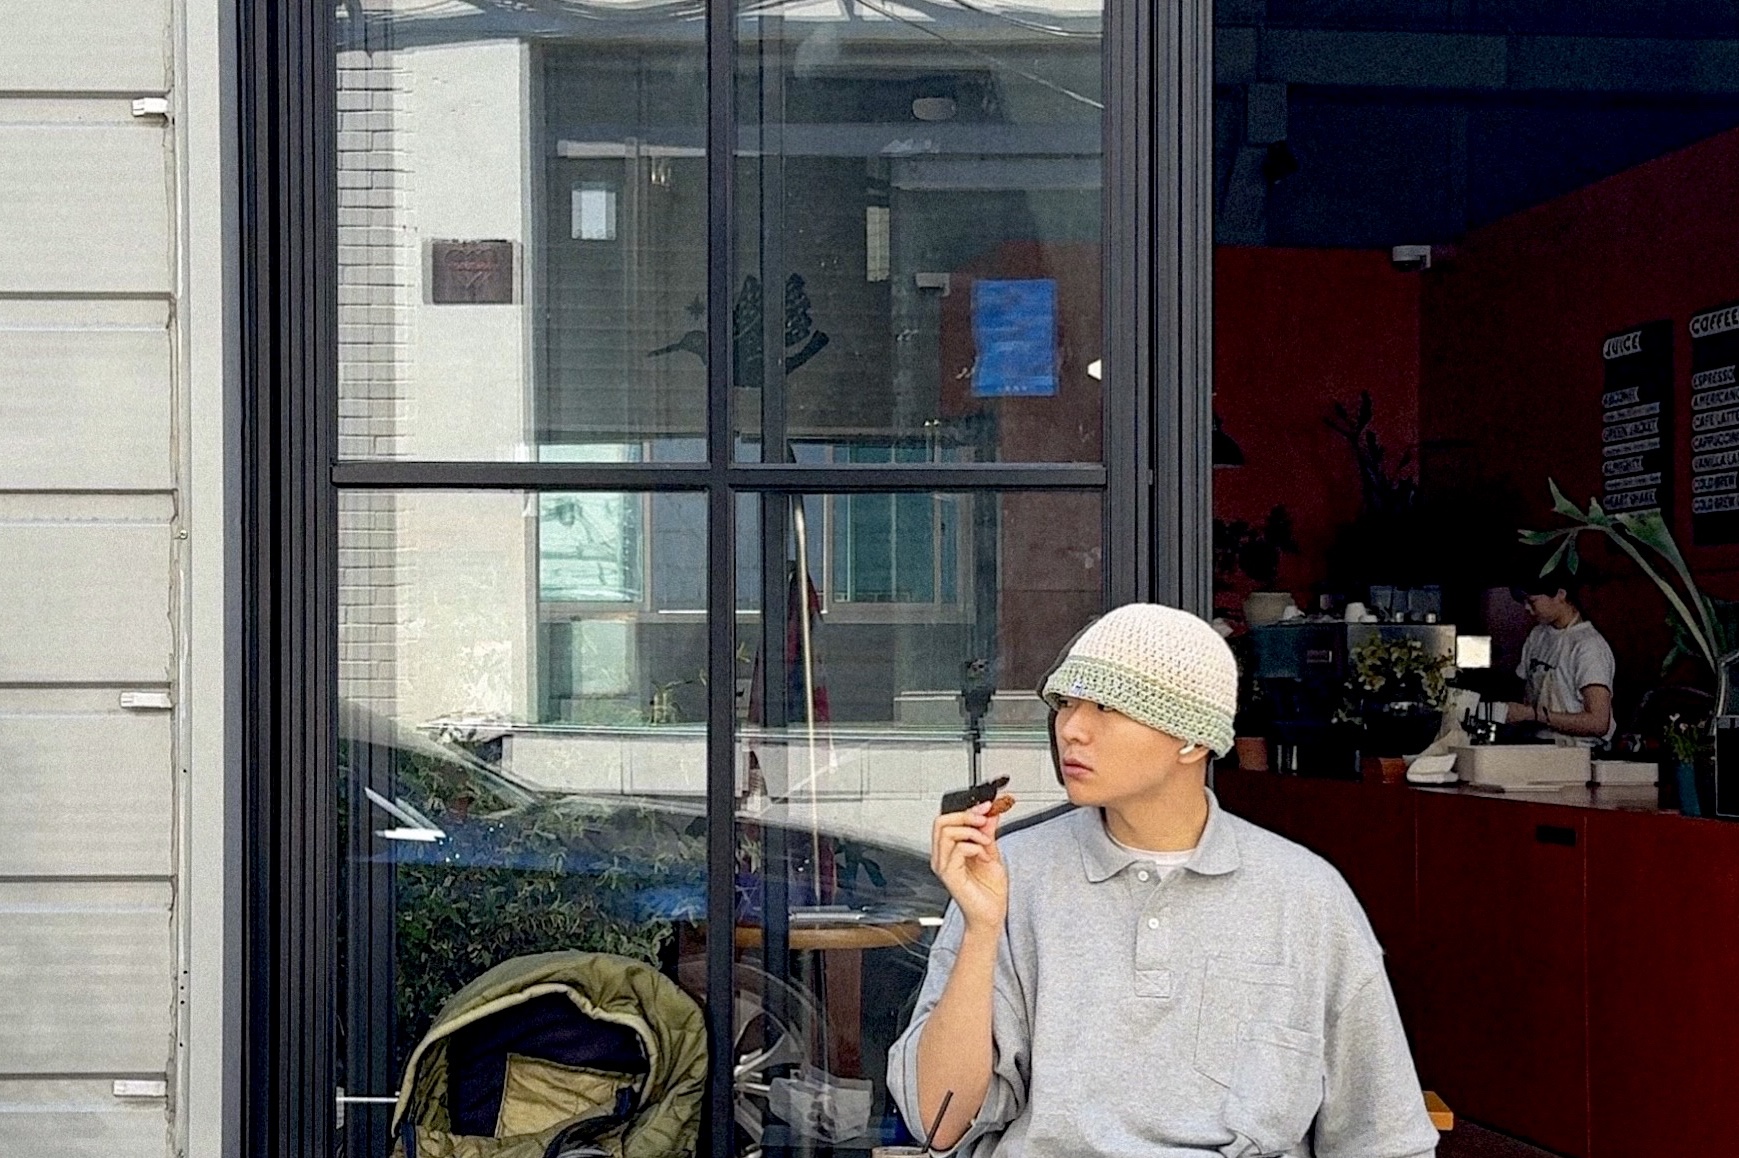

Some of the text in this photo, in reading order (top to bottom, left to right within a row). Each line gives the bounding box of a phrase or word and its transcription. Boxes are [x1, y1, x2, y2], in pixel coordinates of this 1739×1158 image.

[1691, 307, 1739, 335] COFFEE
[1605, 334, 1639, 357] JUICE
[1692, 367, 1734, 388] ESPRESSO
